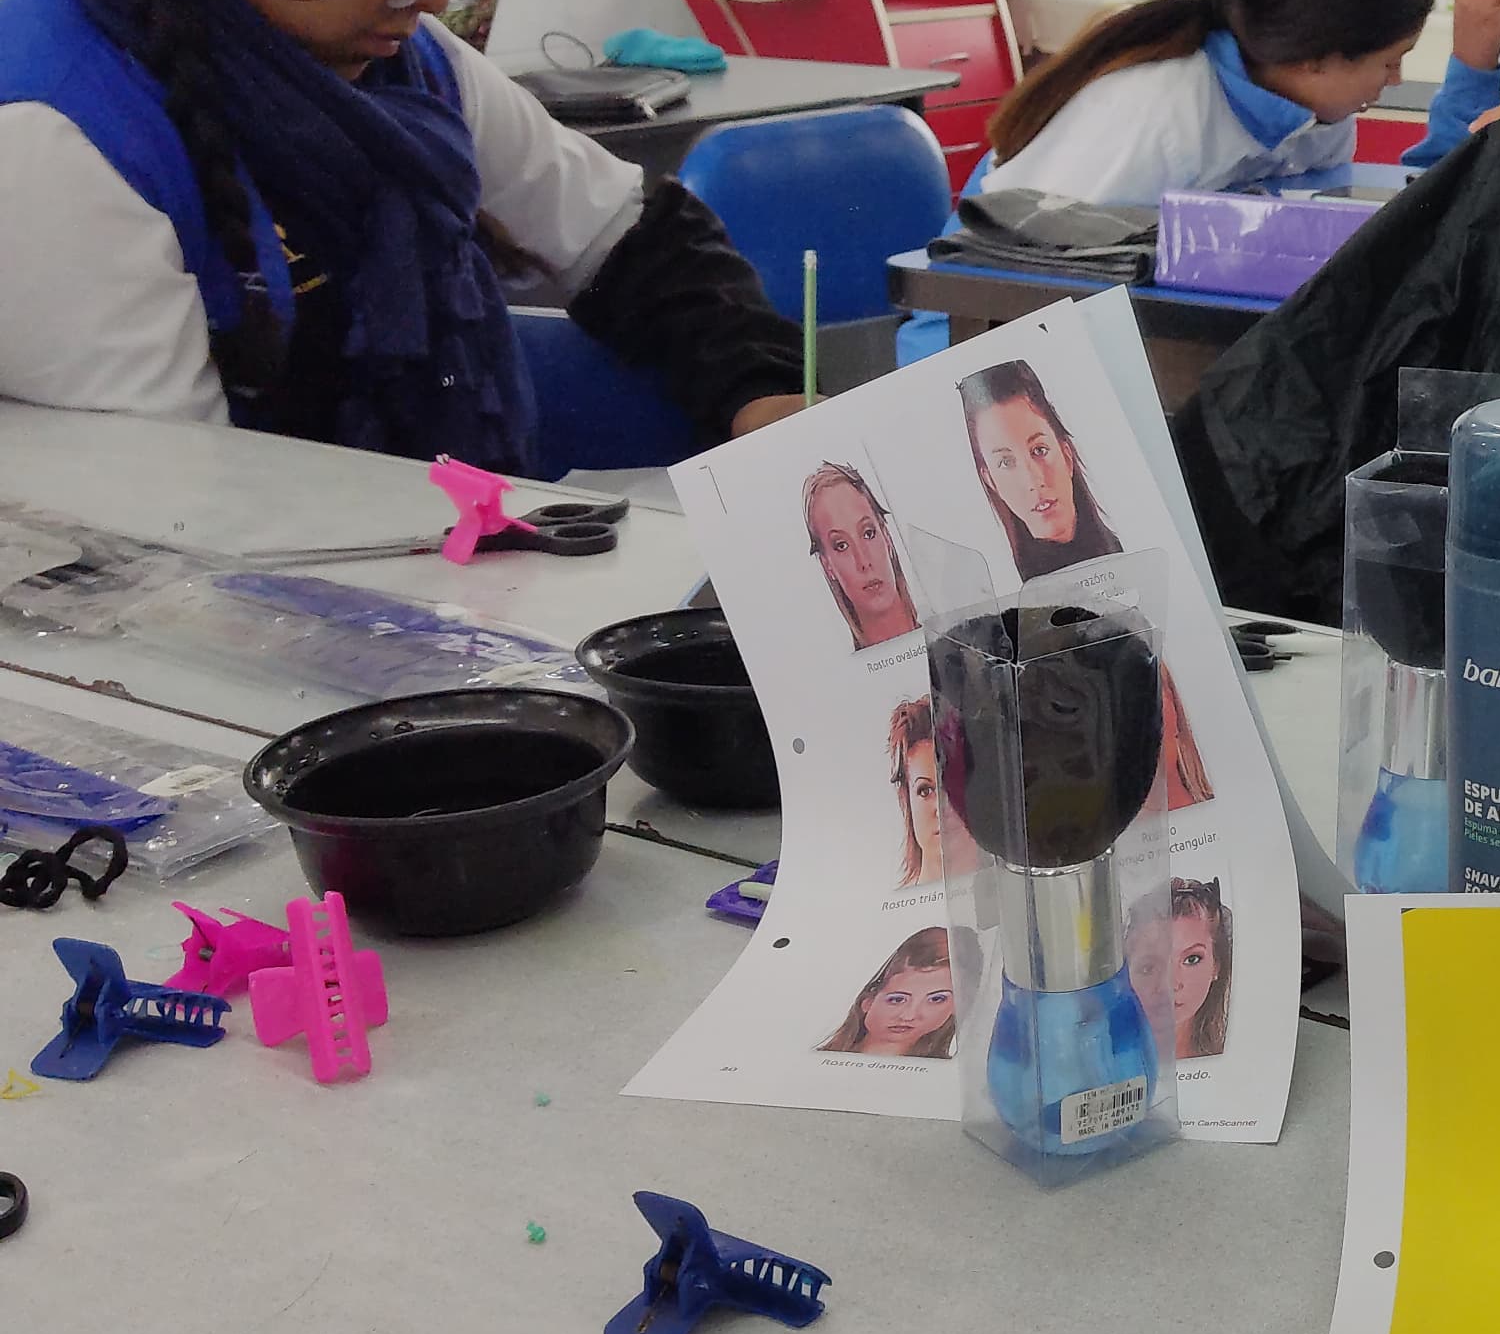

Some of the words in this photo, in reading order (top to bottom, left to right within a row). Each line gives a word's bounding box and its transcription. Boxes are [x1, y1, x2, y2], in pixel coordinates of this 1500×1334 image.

[866, 657, 895, 675] Rostro
[1464, 798, 1483, 818] DE
[1464, 817, 1498, 835] Espuma
[1464, 829, 1489, 844] Pieles
[881, 897, 917, 911] Rostro
[820, 1058, 864, 1068] Rostro
[867, 1061, 929, 1073] diamante.
[1197, 1119, 1258, 1127] CamScanner
